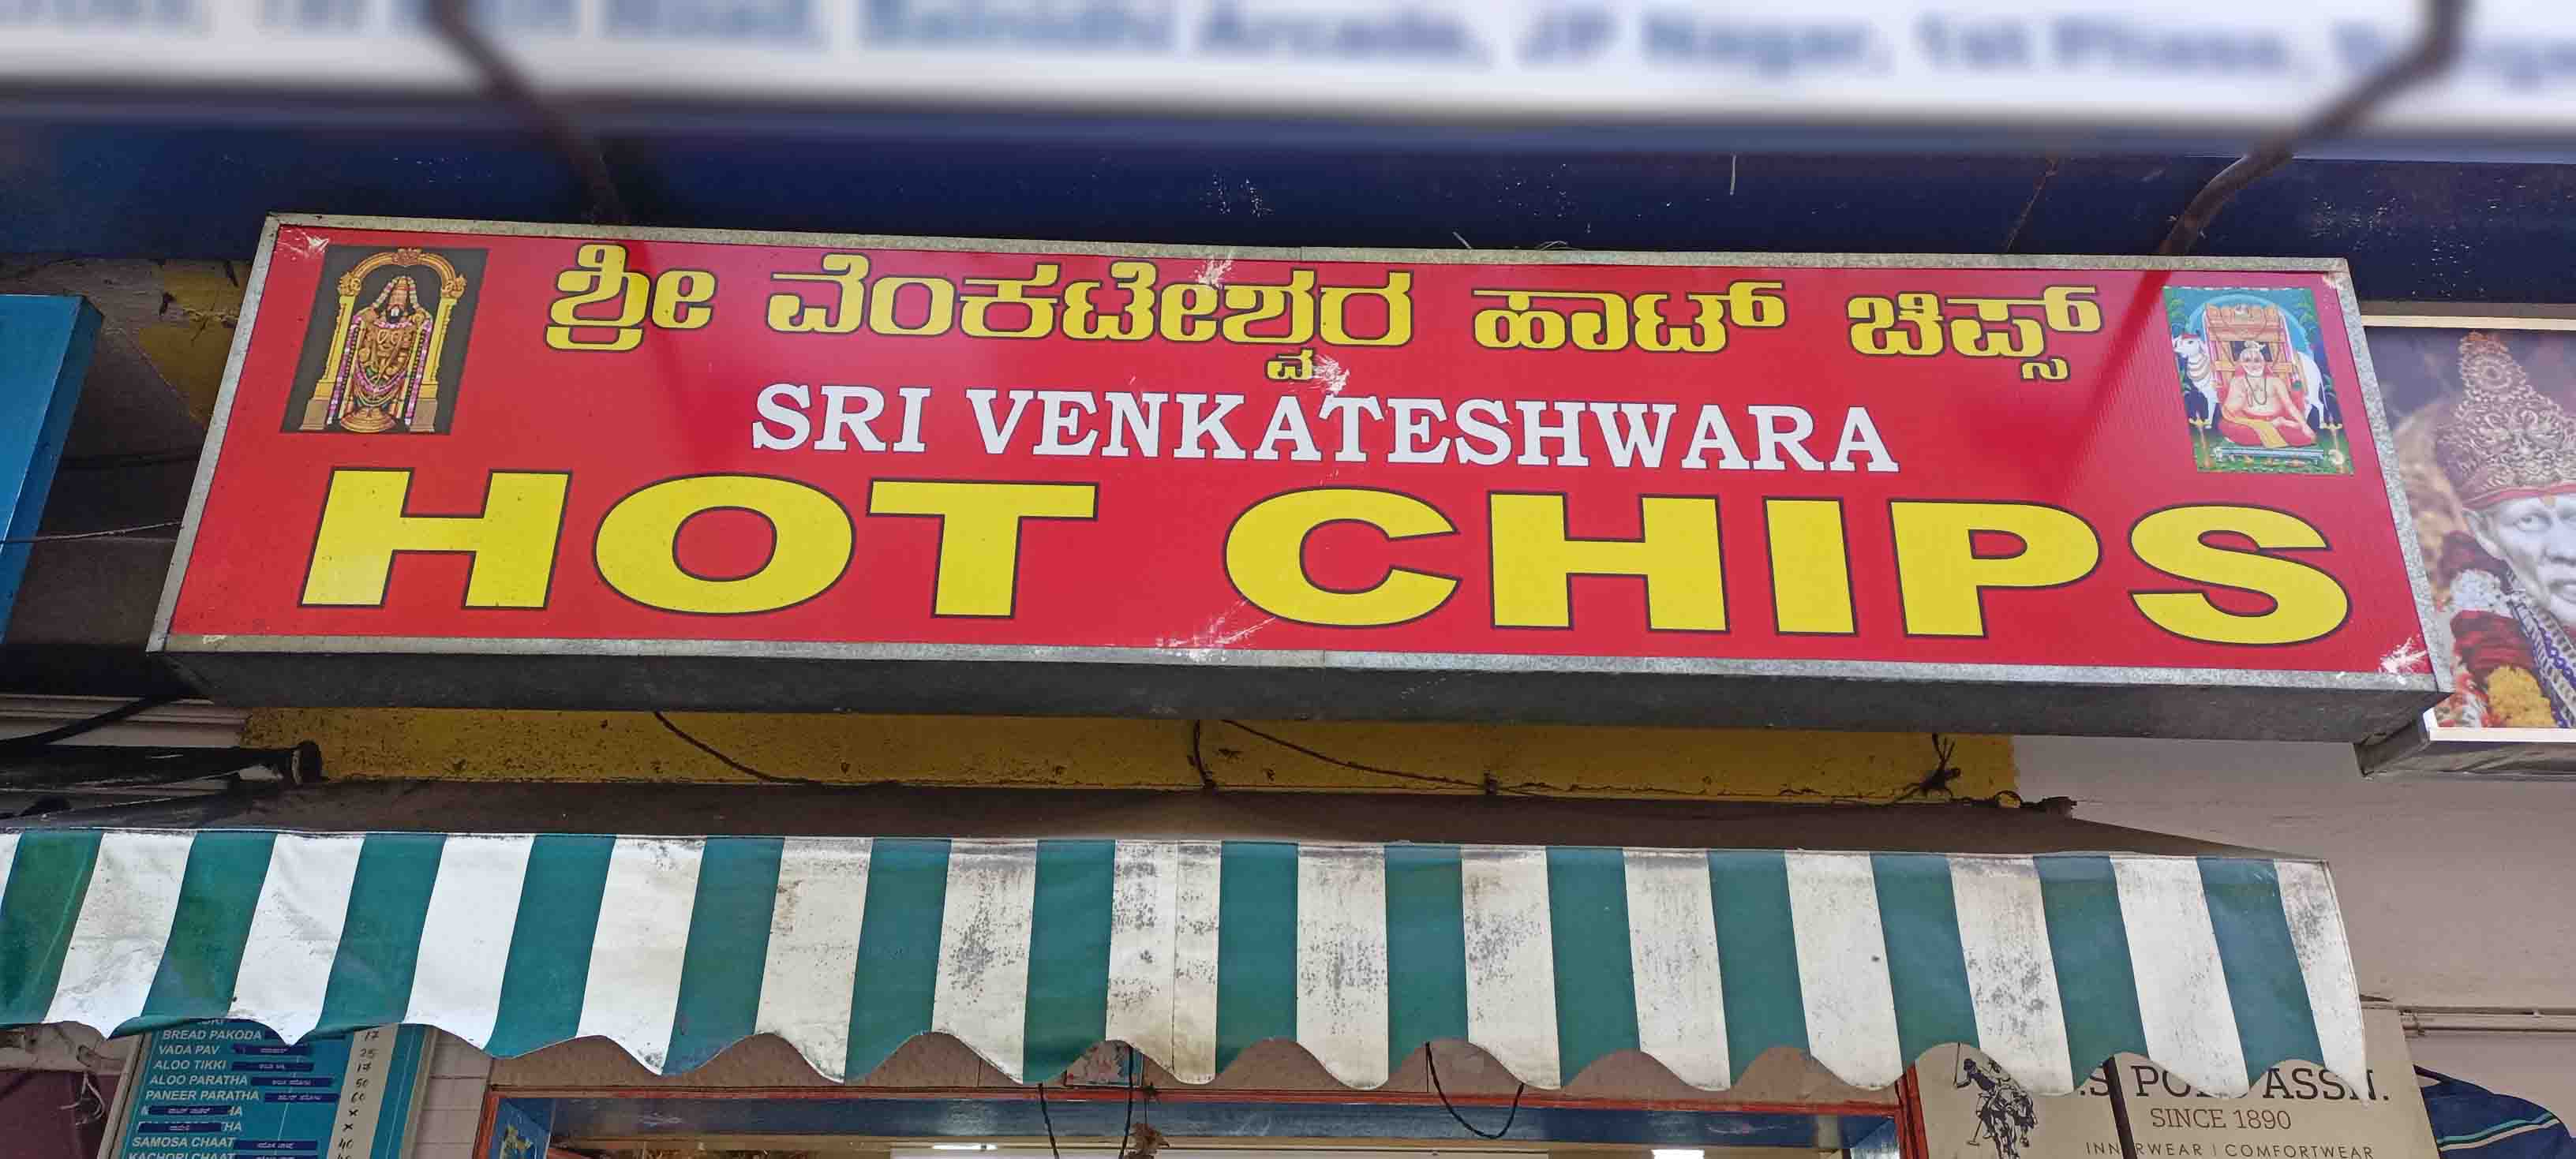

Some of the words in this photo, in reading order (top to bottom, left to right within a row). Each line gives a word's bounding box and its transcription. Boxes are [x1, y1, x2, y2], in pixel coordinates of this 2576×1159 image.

[545, 243, 717, 352] ಶ್ರೀ
[766, 252, 1413, 382] ವೆಂಕಟೇಶ್ವರ
[1472, 280, 1786, 352] ಹಾಟ್
[1846, 284, 2103, 380] ಚಿಪ್ಸ್
[752, 383, 931, 454] SRI
[965, 388, 1900, 473] VENKATESHWARA
[298, 467, 1098, 618] HOT
[1223, 484, 2349, 645] CHIPS
[163, 1030, 206, 1040] BREAD
[209, 1030, 263, 1040] PAKODA
[159, 1045, 192, 1055] VADA
[195, 1045, 220, 1055] PAV
[153, 1060, 190, 1070] ALOO
[195, 1060, 227, 1070] TIKKI
[150, 1075, 186, 1086] ALOO
[189, 1075, 248, 1086] PARATHA
[145, 1090, 197, 1101] PANEER
[200, 1090, 260, 1101] PARATHA
[2151, 1108, 2227, 1128] SINCE
[2233, 1109, 2292, 1130] 1890
[132, 1137, 189, 1148] SAMOSA
[191, 1137, 237, 1148] CHAAT
[2086, 1142, 2203, 1156] INNRWEAR
[2225, 1144, 2375, 1159] COMFORTWEAR
